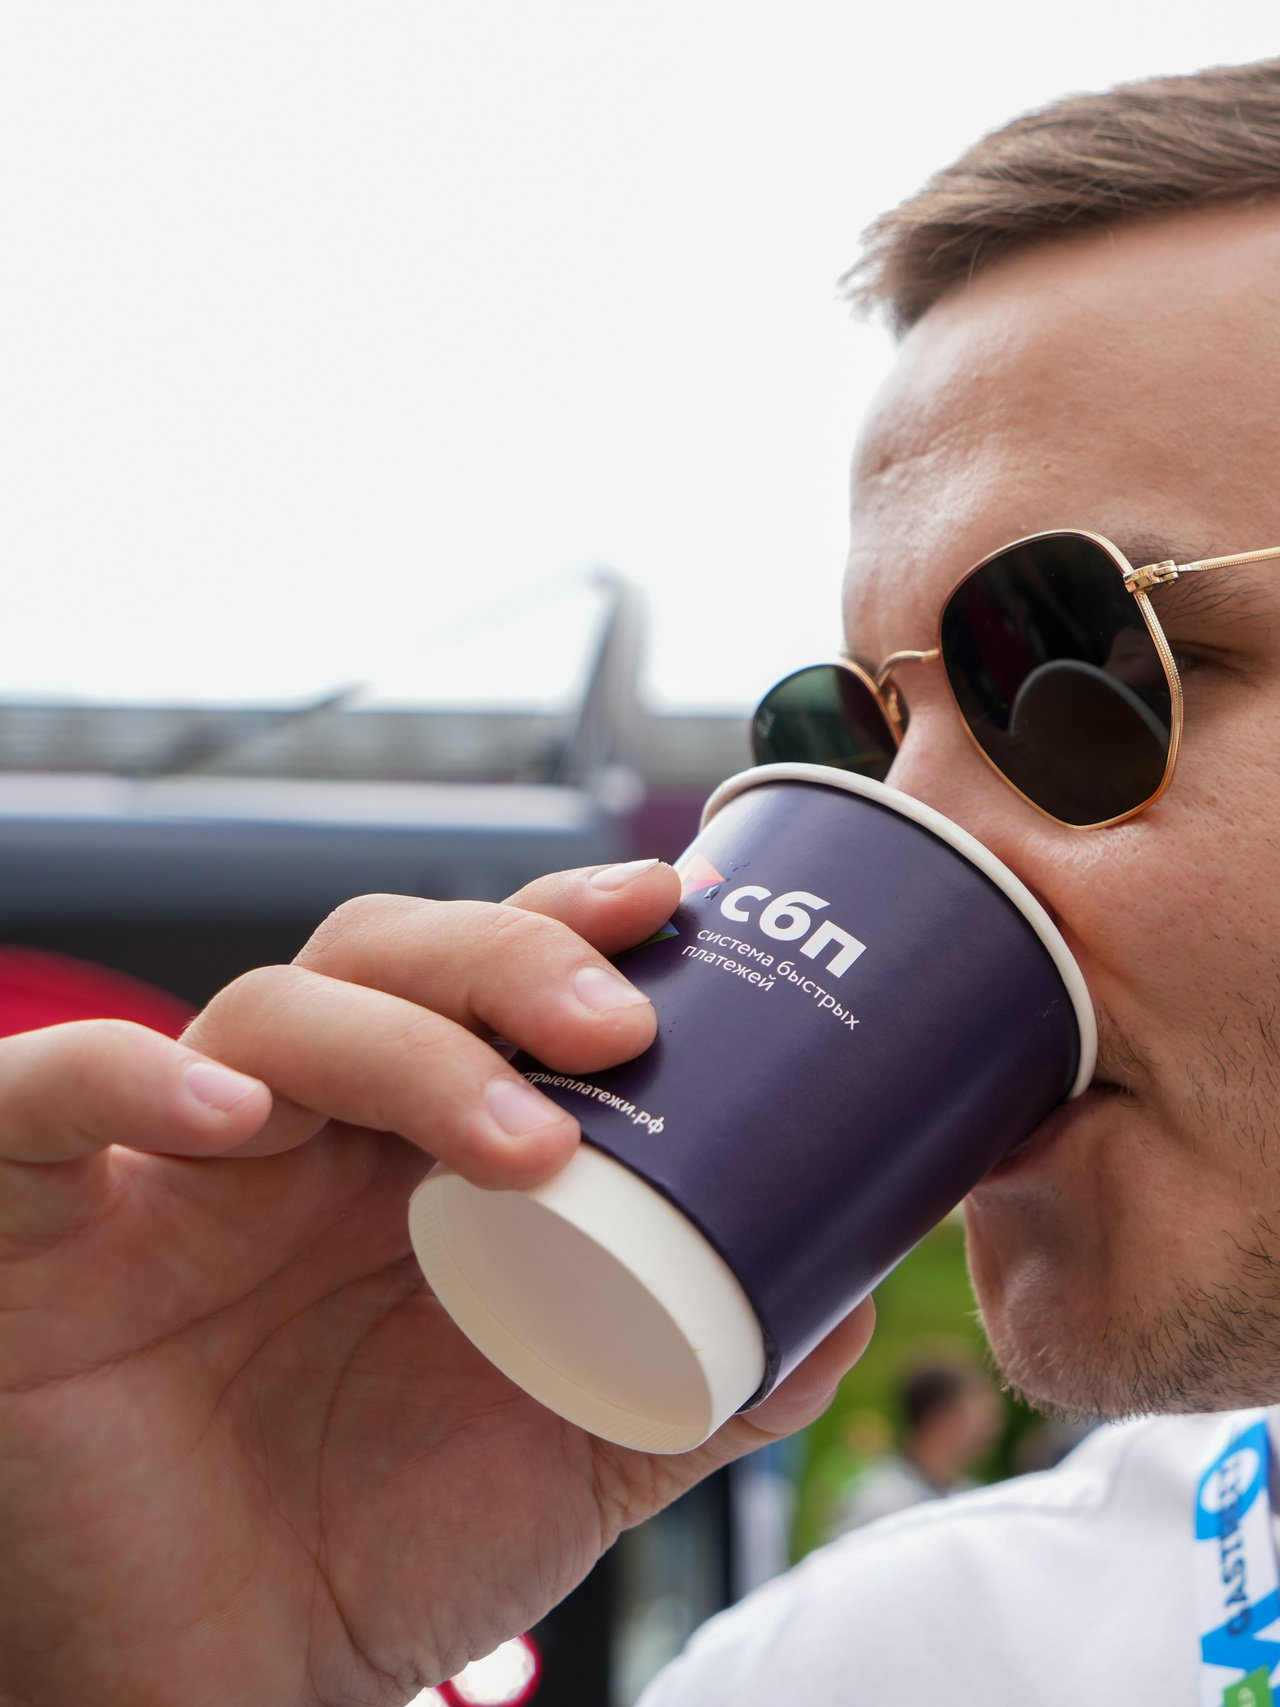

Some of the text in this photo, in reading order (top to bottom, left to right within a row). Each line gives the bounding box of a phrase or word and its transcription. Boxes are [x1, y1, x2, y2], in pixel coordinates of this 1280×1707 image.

[682, 945, 776, 992] платежей
[720, 885, 868, 979] сбп
[697, 929, 861, 1031] система быстрых
[521, 1071, 666, 1135] стрыеплатежи.рф
